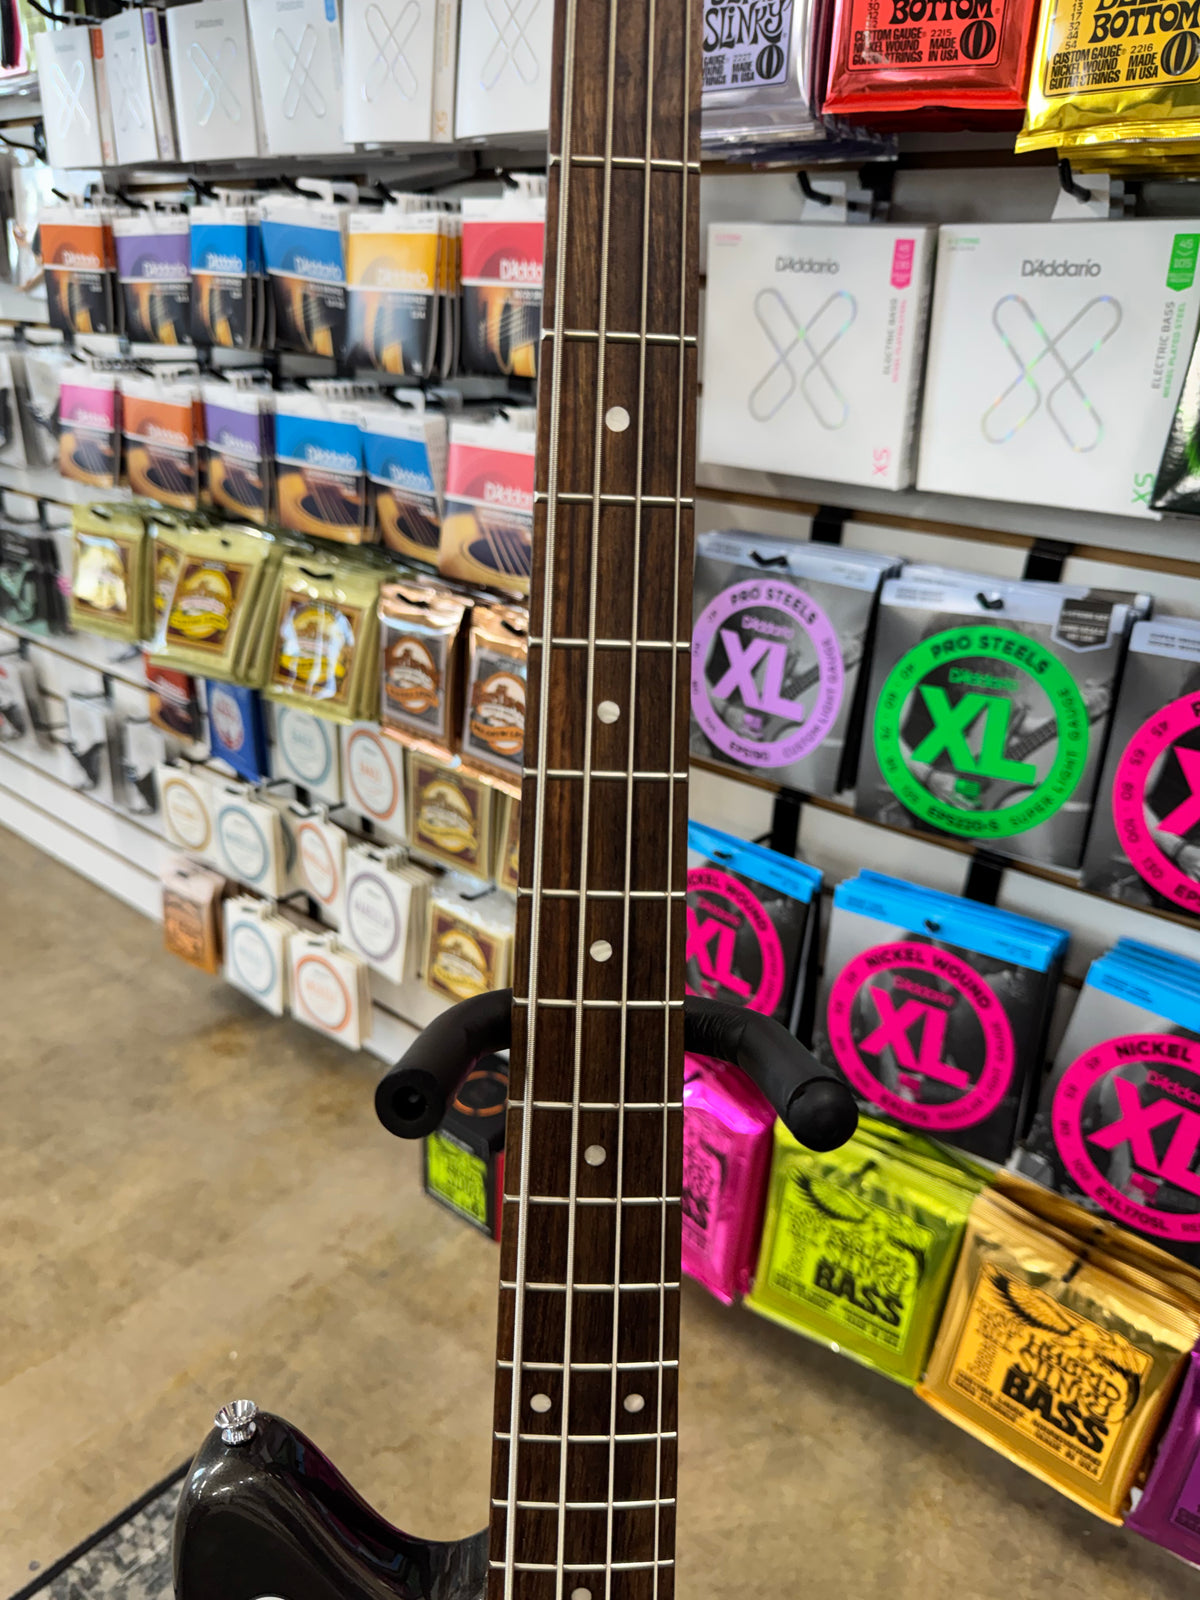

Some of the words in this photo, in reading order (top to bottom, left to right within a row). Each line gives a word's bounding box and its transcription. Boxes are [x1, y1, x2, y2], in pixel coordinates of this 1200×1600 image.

[889, 0, 994, 24] BOTTOM
[1088, 1, 1200, 43] BOTTOM
[854, 29, 891, 42] CUTOM
[893, 27, 923, 40] GAUGE
[929, 37, 957, 50] MADE
[931, 29, 952, 38] 2215
[853, 41, 883, 54] NIKEL
[886, 40, 920, 52] WOUND
[928, 51, 938, 62] IN
[940, 50, 958, 61] USA
[1053, 49, 1090, 66] CUSTOM
[1091, 44, 1122, 60] GAUGE
[1130, 43, 1154, 54] 2216
[1051, 62, 1081, 78] NICKEL
[1082, 57, 1119, 73] WOUND
[1129, 52, 1158, 68] MADE
[1049, 74, 1080, 90] GUITAR
[1080, 70, 1121, 85] STRINGS
[1126, 68, 1137, 81] IN
[1138, 66, 1159, 80] USA
[1020, 258, 1102, 278] D'Addario
[1151, 334, 1170, 390] ELECTRIC
[730, 587, 761, 604] PRO
[766, 588, 817, 625] STEELS
[930, 635, 971, 661] PRO
[978, 636, 1052, 676] STEELS
[711, 628, 805, 722] XL
[1056, 686, 1082, 743] GAUGE
[910, 684, 1038, 786] XL
[687, 906, 752, 998] XL
[865, 948, 926, 970] NICKEL
[932, 954, 992, 1010] WOUND
[858, 984, 972, 1090] XL
[1114, 1040, 1193, 1063] NICKEL
[1087, 1075, 1200, 1198] XL
[814, 1256, 904, 1328] BASS
[1001, 1362, 1110, 1454] BASS
